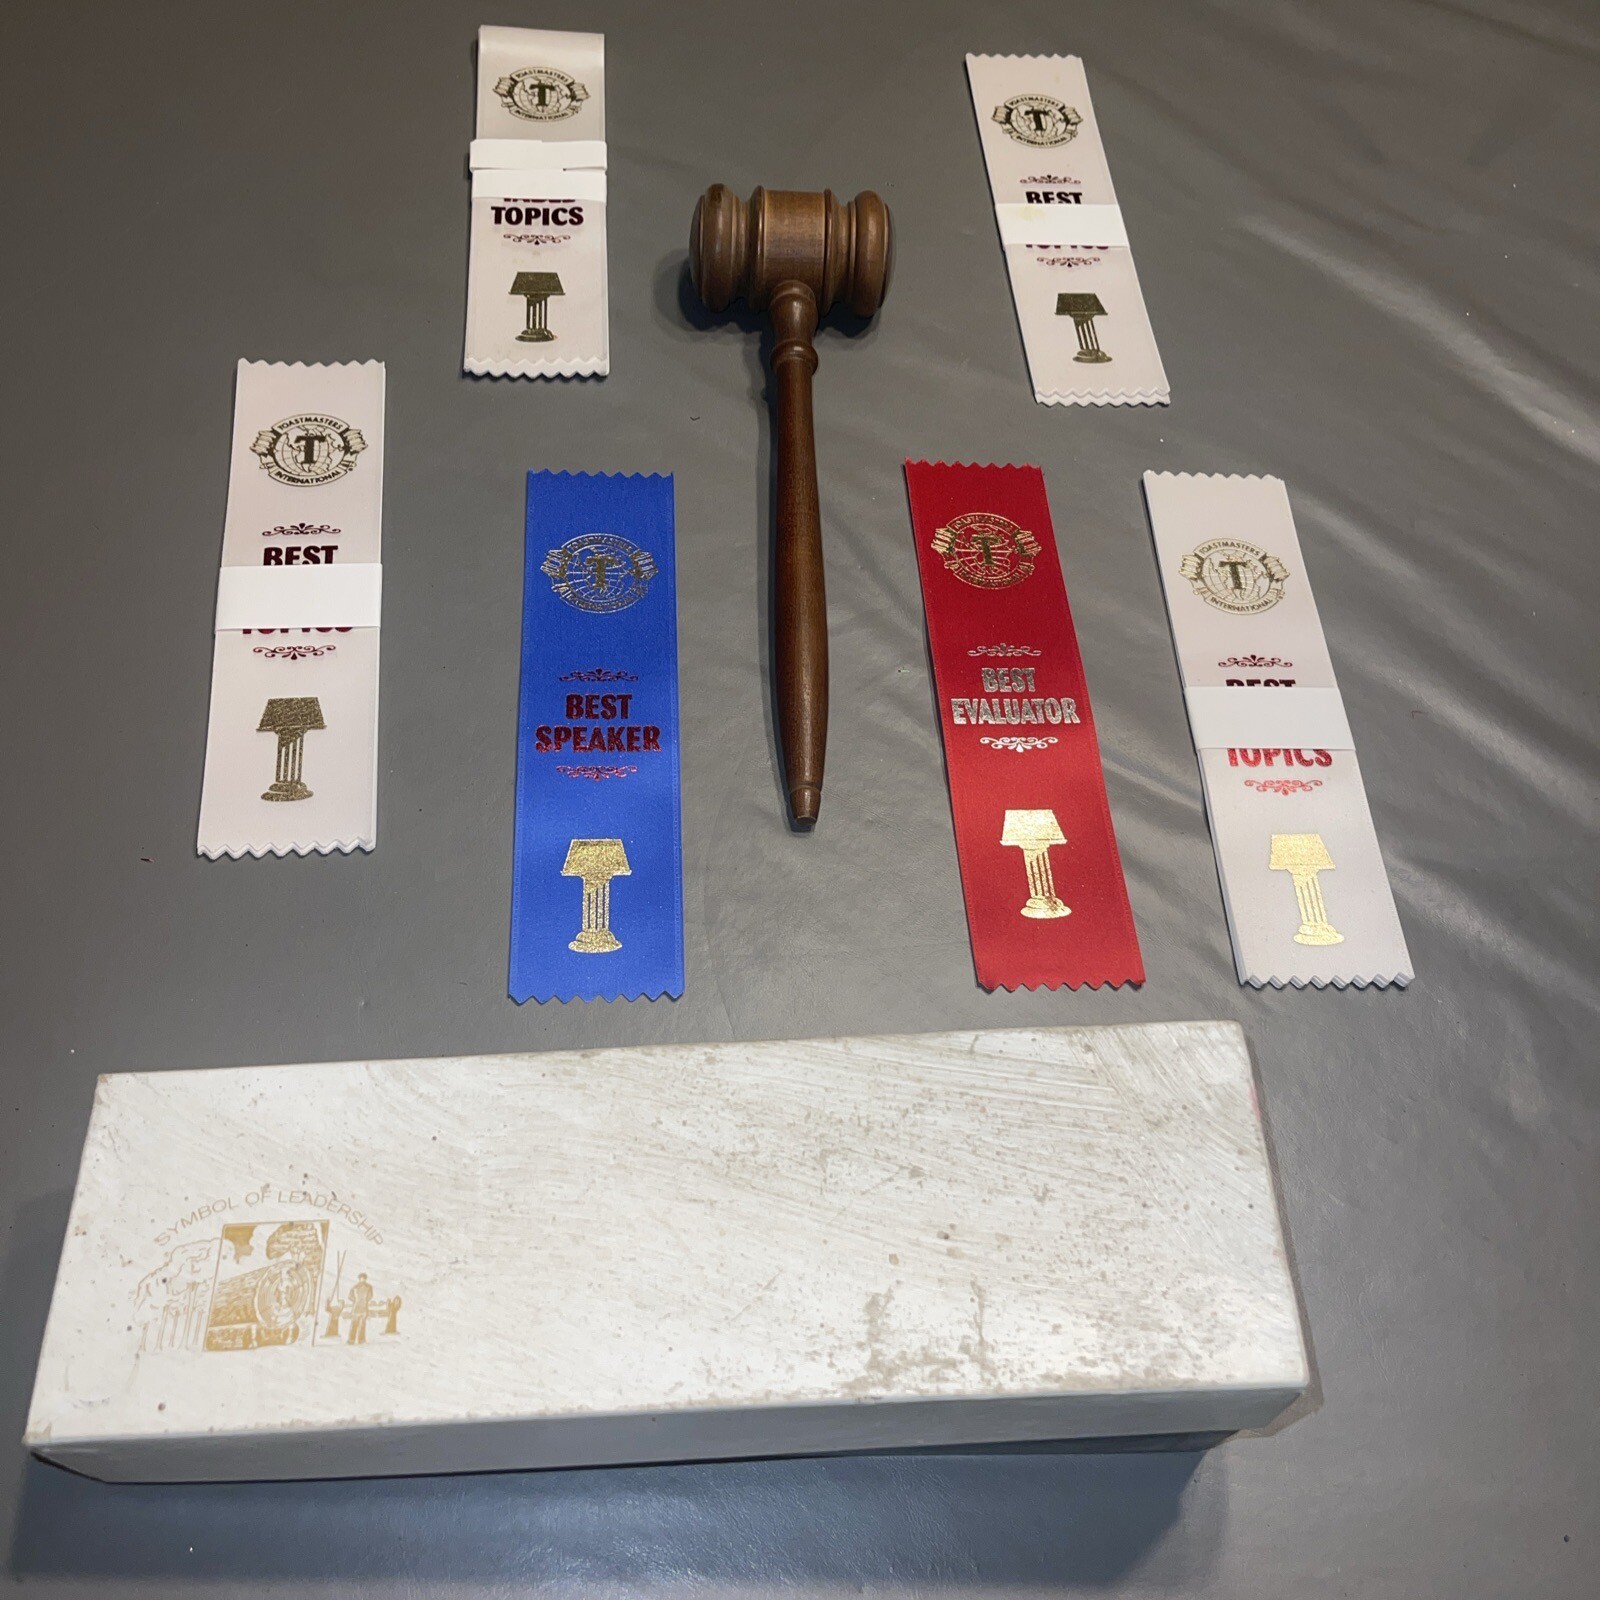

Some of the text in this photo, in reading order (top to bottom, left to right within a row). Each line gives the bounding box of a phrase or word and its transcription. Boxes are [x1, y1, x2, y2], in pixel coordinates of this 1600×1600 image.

[529, 83, 556, 107] T
[1024, 109, 1050, 131] T
[490, 206, 584, 226] TOPICS
[277, 417, 344, 431] TOASTMASTERS
[294, 435, 327, 464] T
[274, 470, 342, 484] INTERNATIONAL
[263, 545, 339, 566] BEST
[970, 535, 1002, 566] T
[1200, 541, 1261, 556] TOASTMASTERS
[584, 556, 617, 589] T
[1218, 561, 1248, 589] T
[1211, 597, 1273, 612] INTERNATIONAL
[981, 667, 1036, 692] BEST
[565, 693, 632, 720] BEST
[951, 697, 1081, 725] EVALUATOR
[535, 725, 662, 752] SPEAKER
[1226, 748, 1333, 767] TOPICS
[154, 1190, 385, 1248] SYMBOL OF LEADERSHIP
